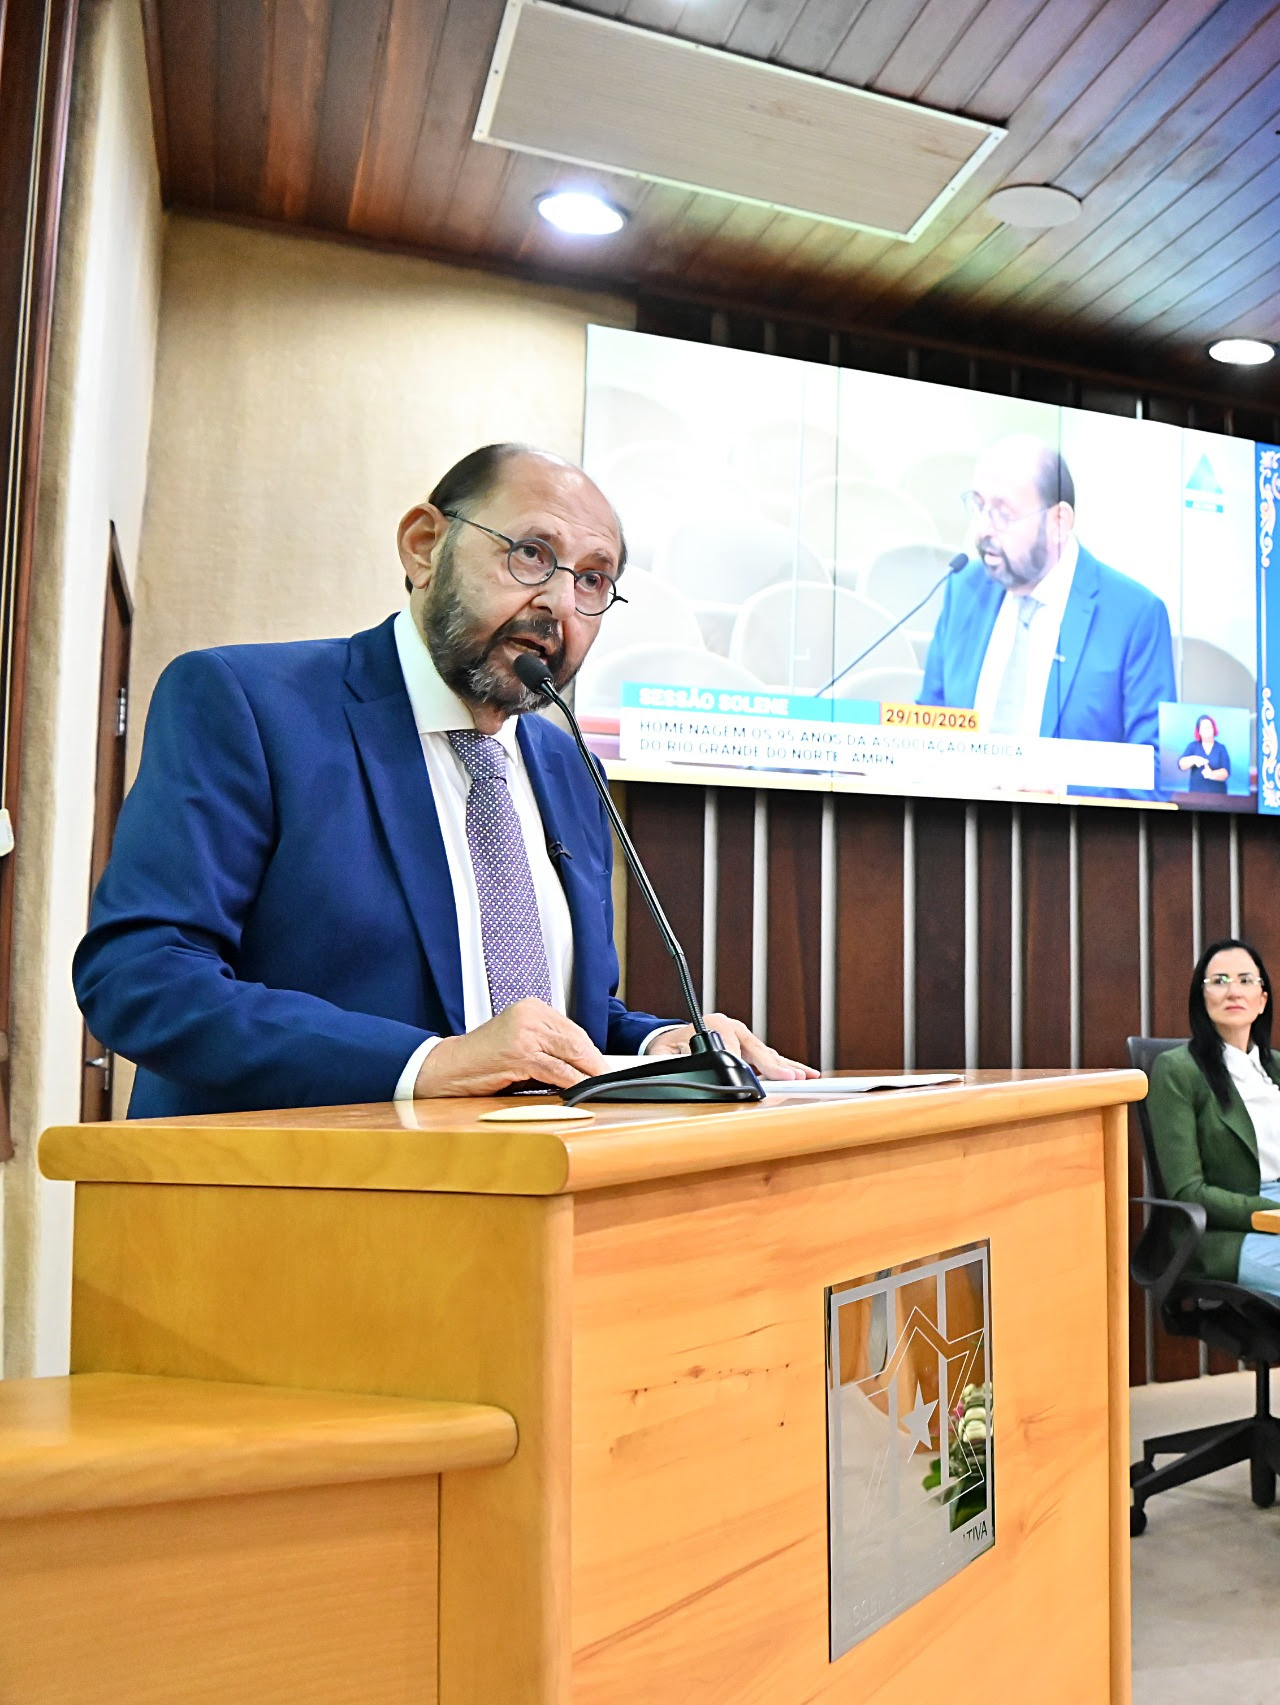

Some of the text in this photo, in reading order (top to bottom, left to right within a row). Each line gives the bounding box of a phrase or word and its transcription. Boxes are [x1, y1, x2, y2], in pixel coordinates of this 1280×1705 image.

[639, 687, 789, 716] SESSÃO SOLENE
[886, 709, 977, 729] 29/10/2026
[640, 720, 746, 738] HOMENAGEM
[800, 731, 842, 745] ANOS
[847, 734, 866, 747] DA
[640, 738, 895, 766] DO RIO GRANDE DO NORTE AMRN
[962, 1520, 988, 1542] TIVA
